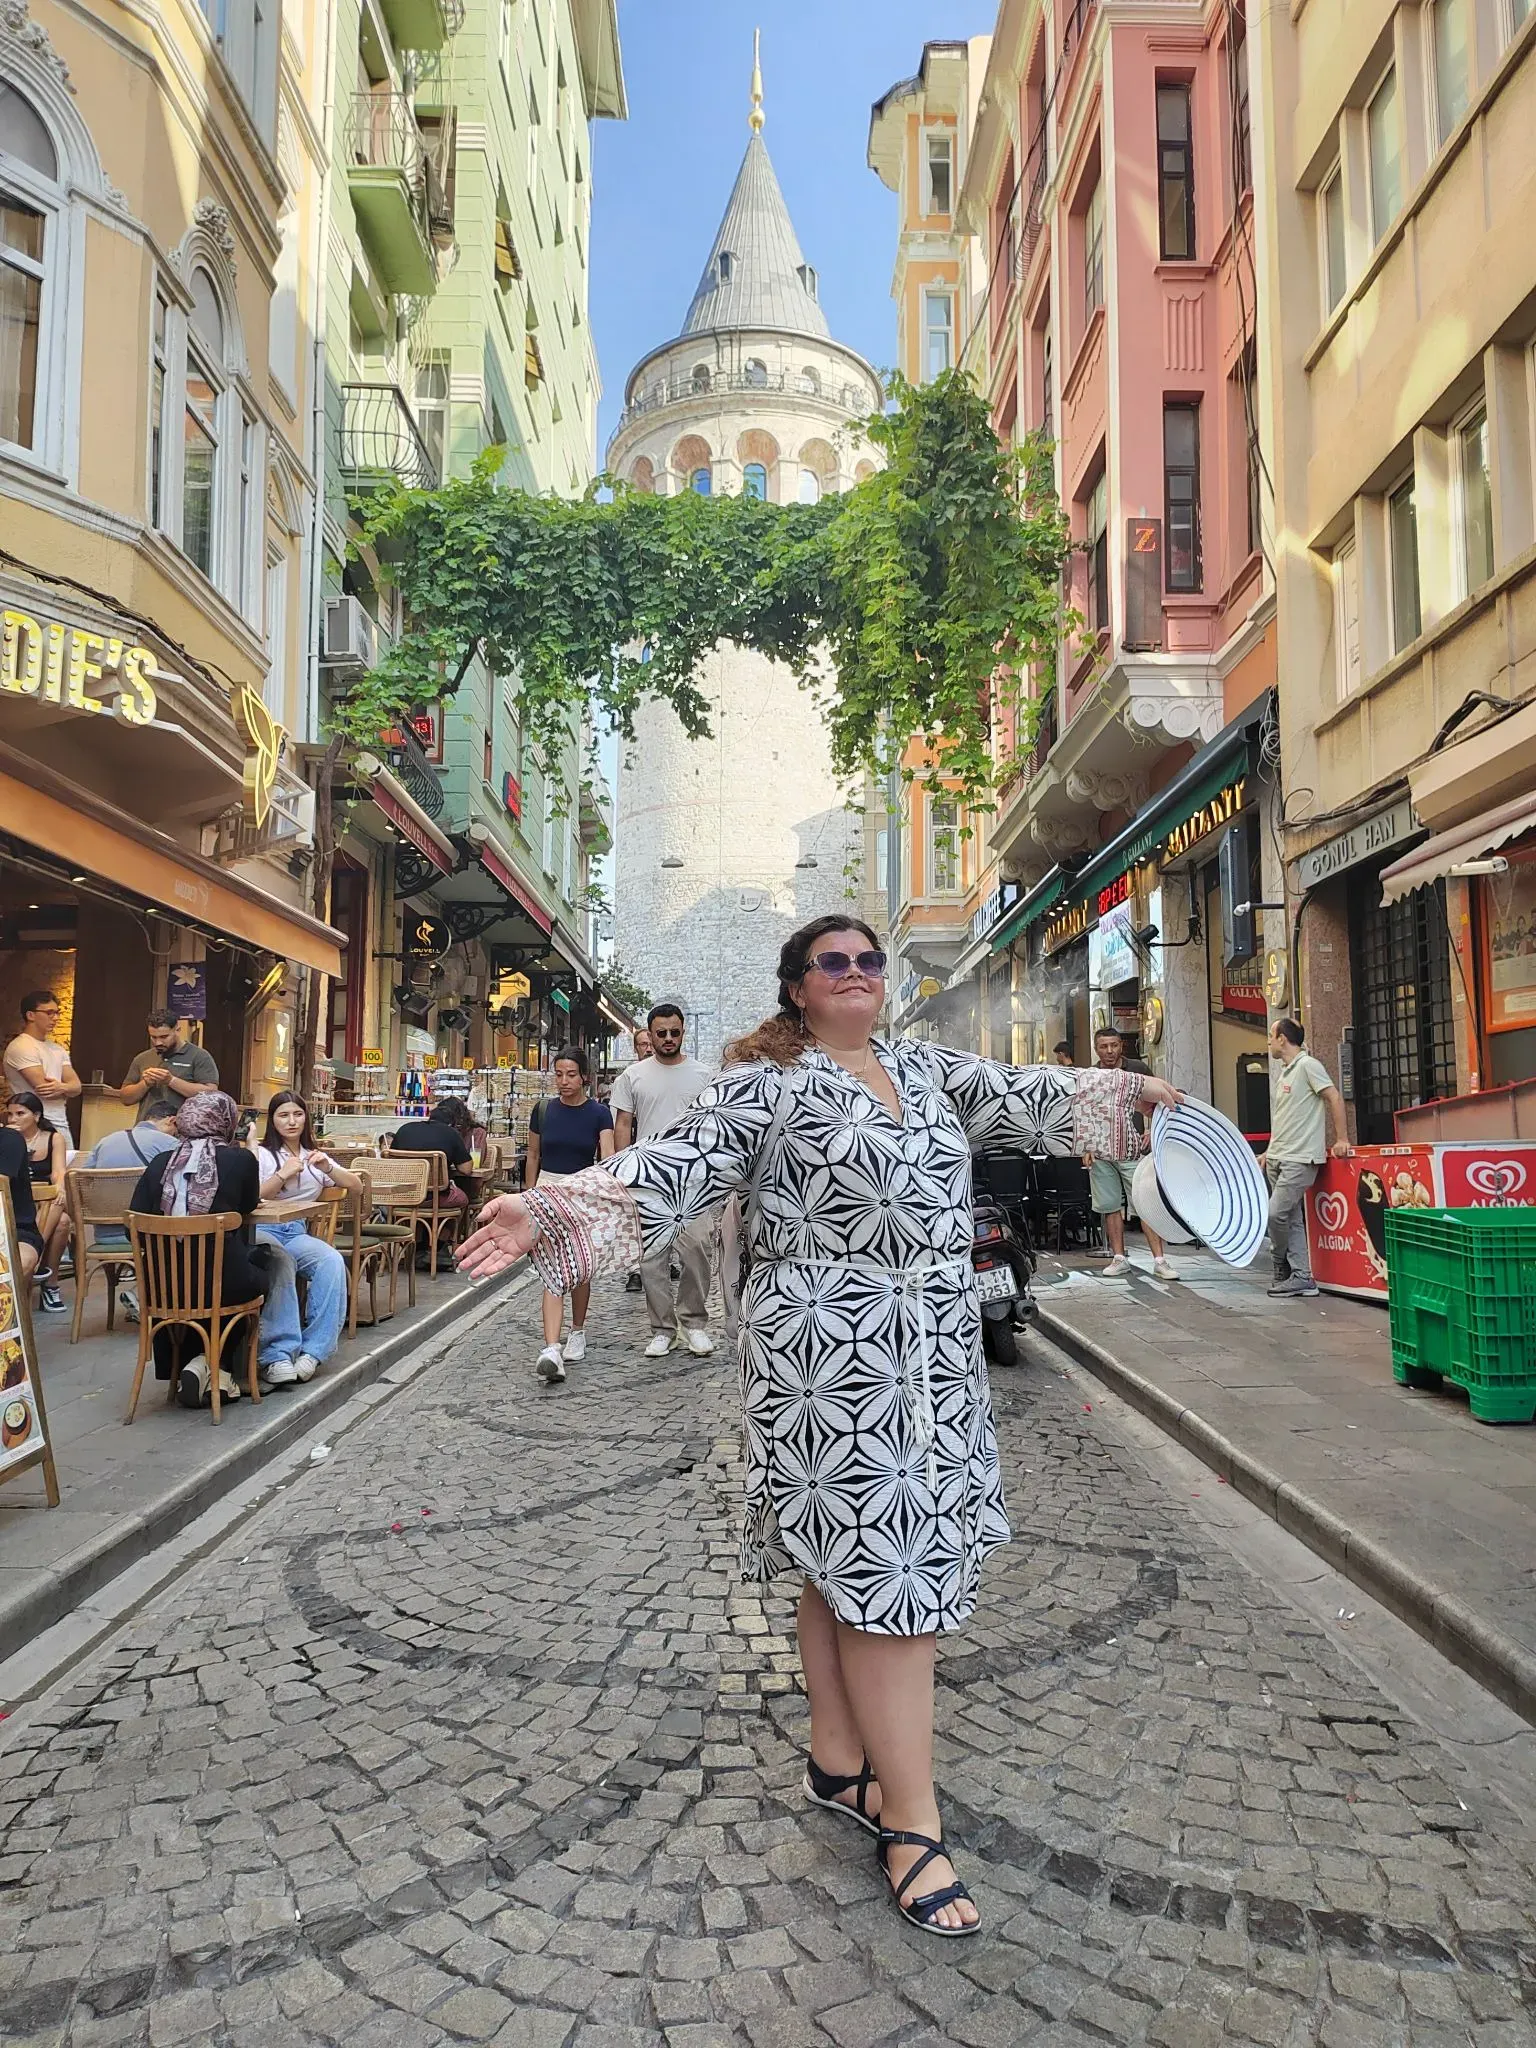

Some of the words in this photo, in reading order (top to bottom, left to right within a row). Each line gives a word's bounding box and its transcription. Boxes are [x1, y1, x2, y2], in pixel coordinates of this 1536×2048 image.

[1310, 834, 1357, 877] GÖNÜL
[1364, 813, 1395, 851] HAN
[364, 1052, 380, 1061] 100
[990, 1269, 1007, 1284] TV
[978, 1283, 1011, 1300] 3253
